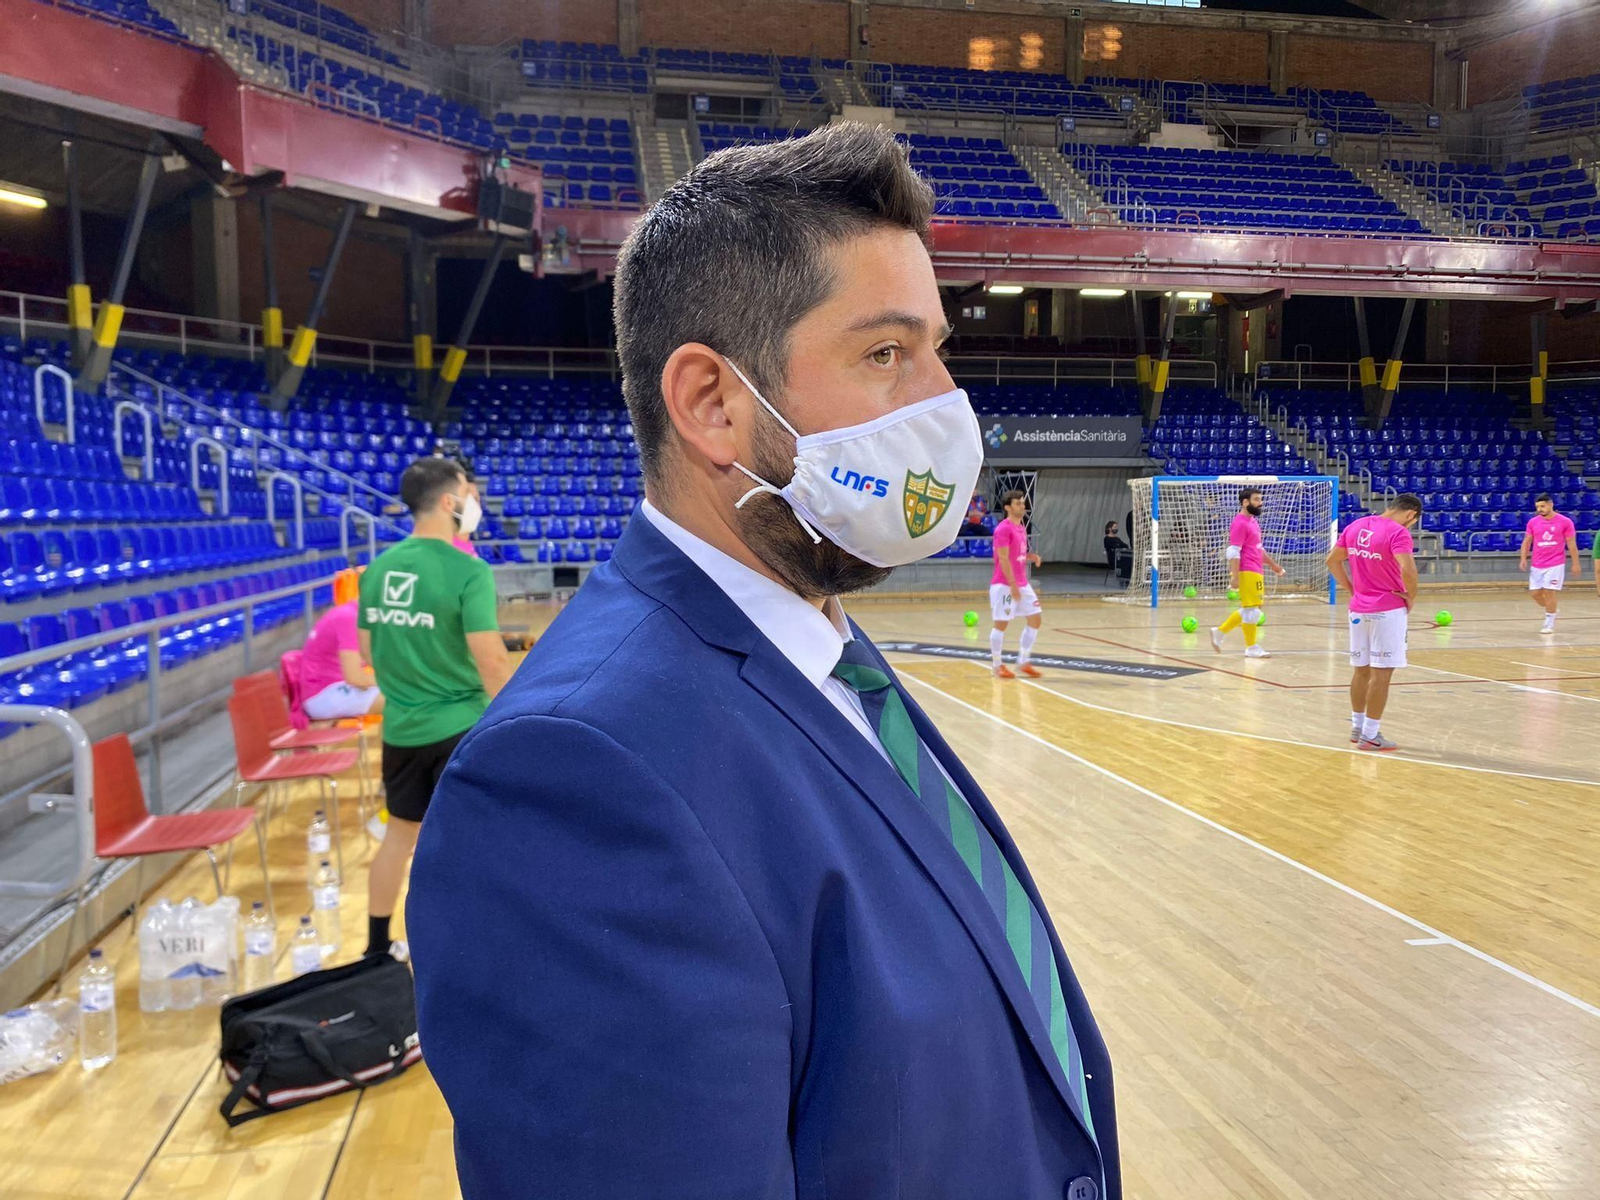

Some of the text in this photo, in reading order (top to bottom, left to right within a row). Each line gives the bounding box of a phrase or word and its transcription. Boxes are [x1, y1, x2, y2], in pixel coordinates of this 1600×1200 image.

[1013, 429, 1127, 442] AssistènciaSanitària
[1002, 595, 1012, 605] 14
[158, 936, 205, 953] VERI
